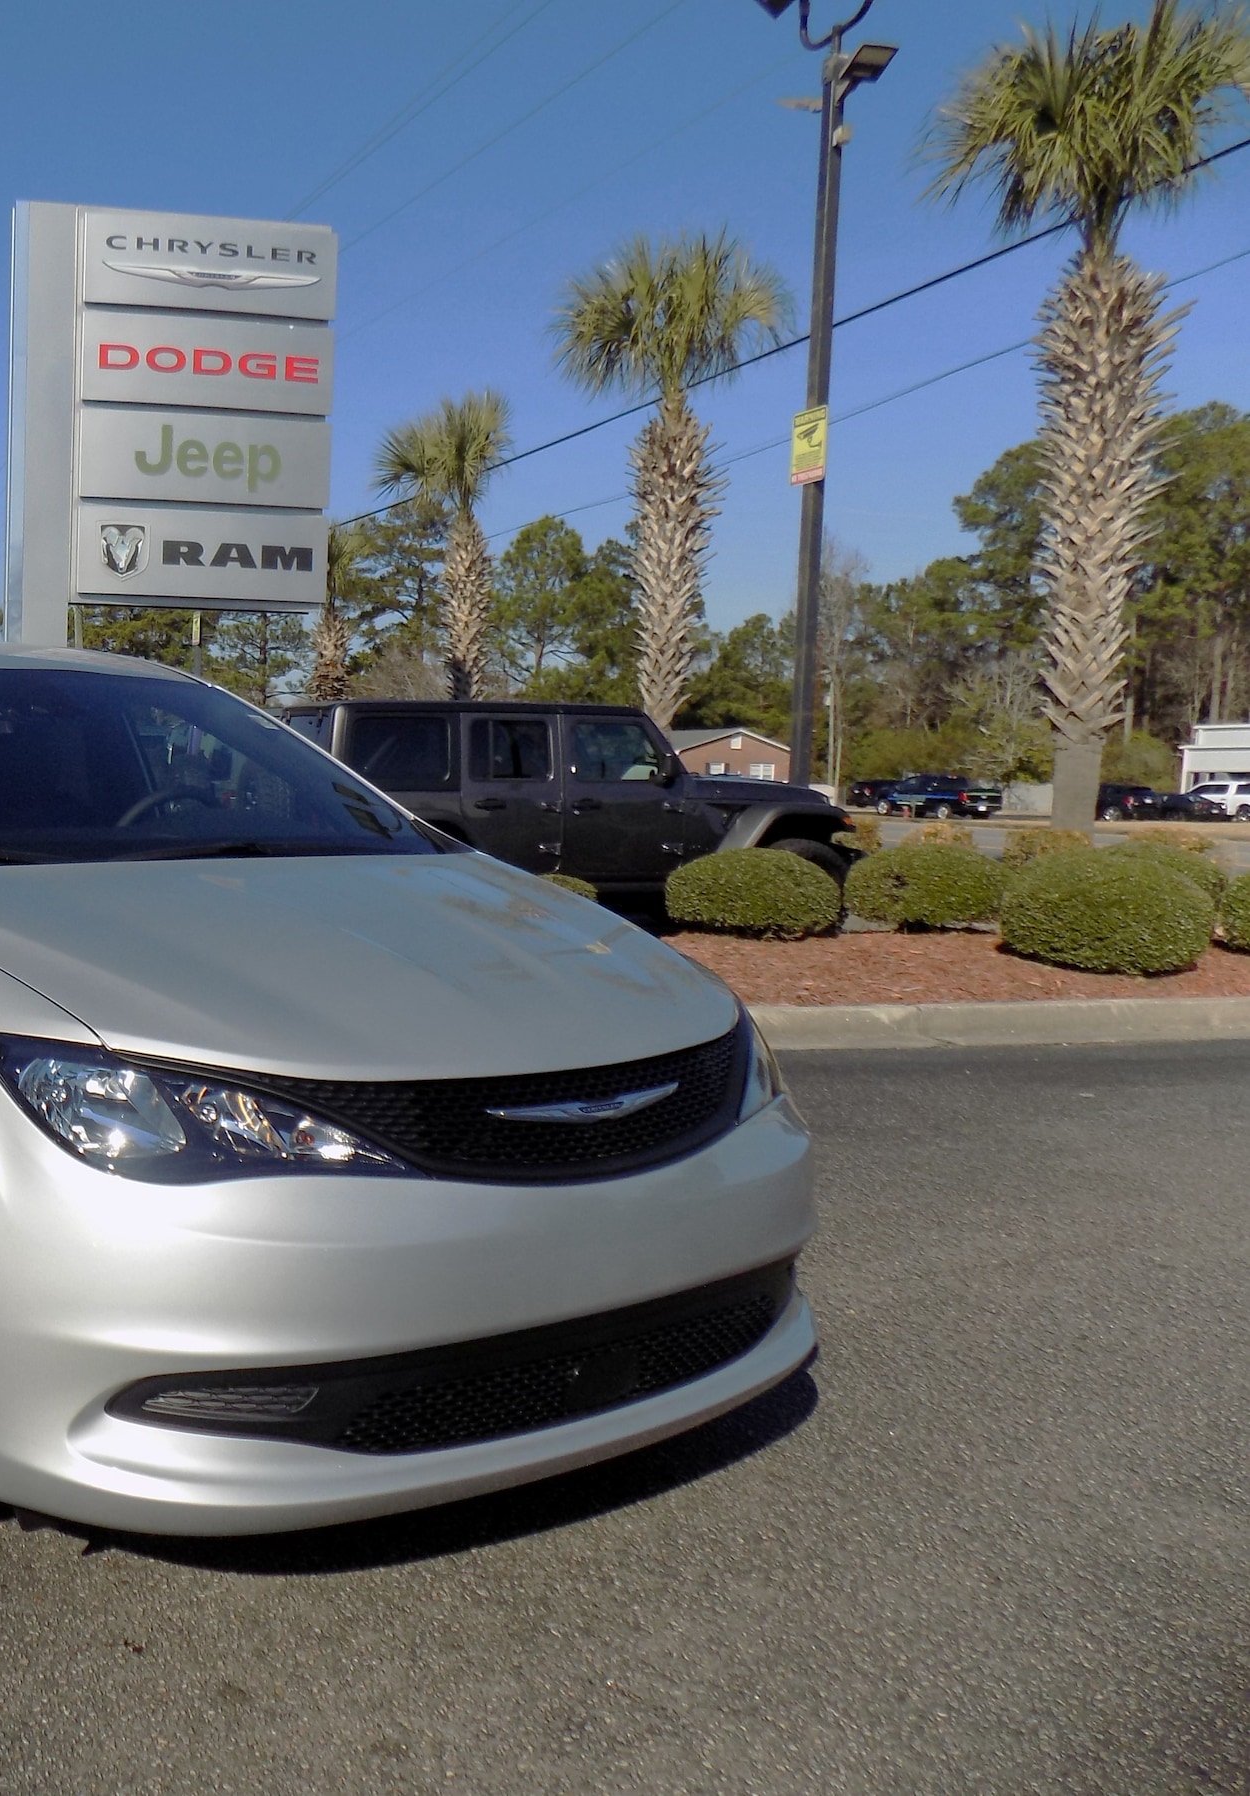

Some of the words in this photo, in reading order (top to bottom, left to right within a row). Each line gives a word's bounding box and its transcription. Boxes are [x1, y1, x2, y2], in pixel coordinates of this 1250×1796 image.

[106, 235, 317, 264] CHRYSLER
[98, 344, 319, 383] DODGE
[135, 424, 281, 492] Jeep
[162, 540, 313, 571] RAM
